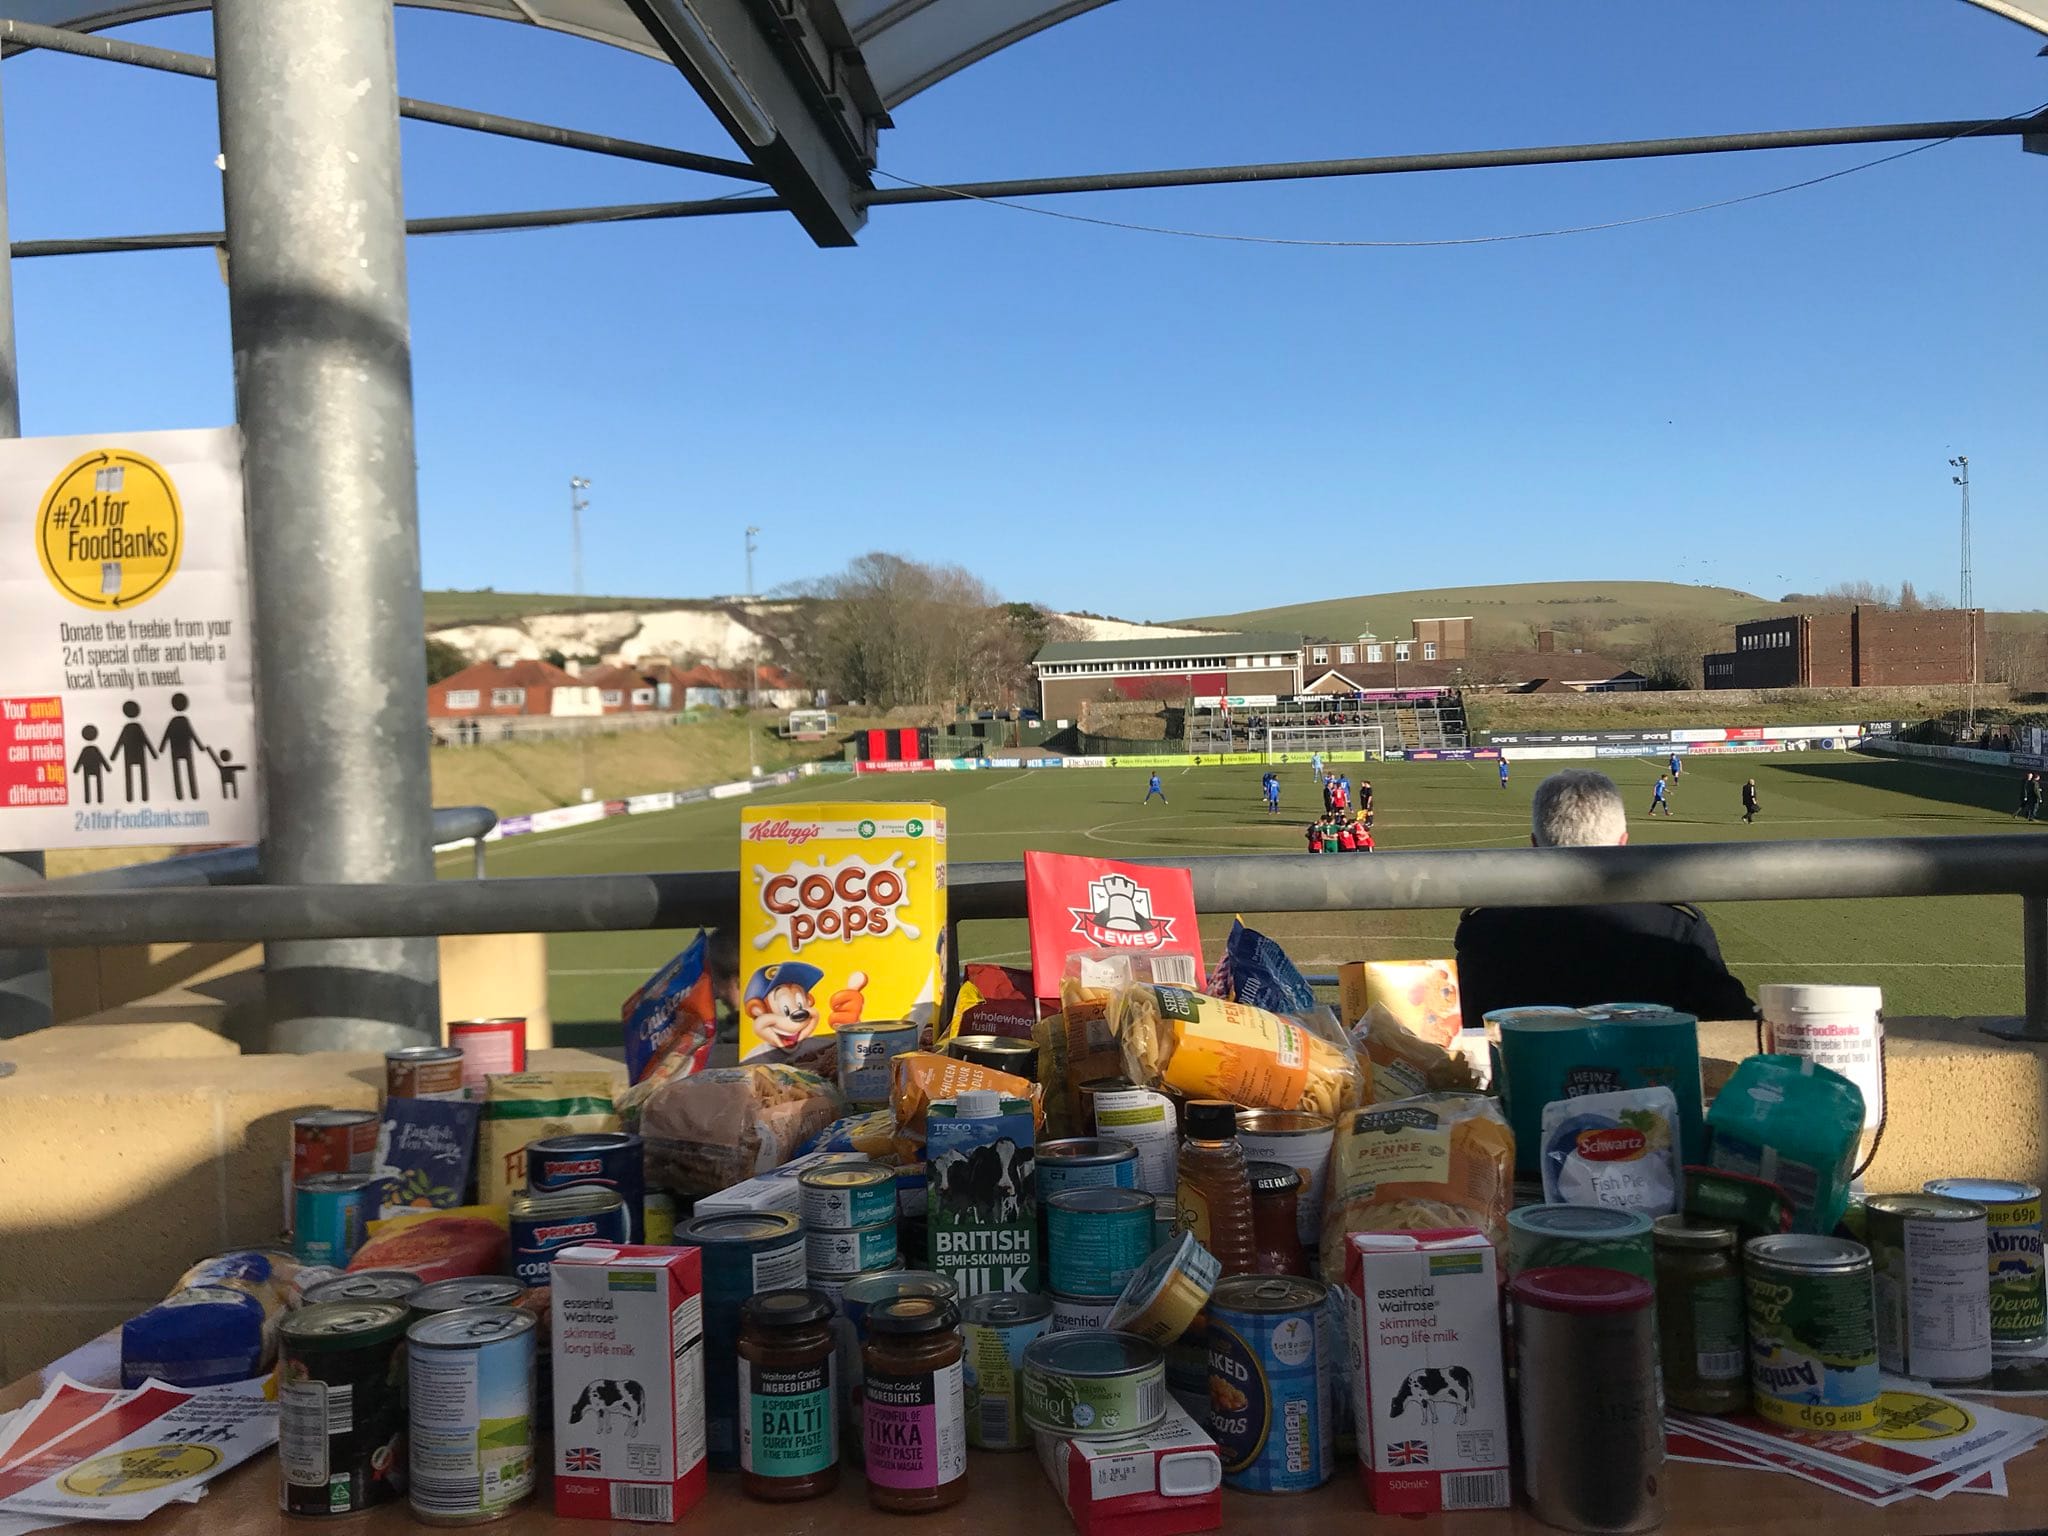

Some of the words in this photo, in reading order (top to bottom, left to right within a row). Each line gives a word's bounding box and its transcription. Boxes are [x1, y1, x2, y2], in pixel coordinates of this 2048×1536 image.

[53, 496, 98, 529] #241
[102, 494, 129, 526] for
[68, 525, 168, 561] FoodBanks
[61, 621, 104, 643] Donate
[106, 620, 126, 640] the
[128, 618, 172, 639] freebie
[174, 617, 205, 638] from
[207, 619, 232, 640] your
[88, 644, 129, 670] special
[132, 643, 160, 664] offer
[165, 641, 187, 662] and
[190, 641, 215, 664] help
[218, 644, 227, 661] a
[65, 668, 95, 690] local
[97, 667, 135, 691] family
[137, 667, 149, 687] in
[4, 700, 28, 719] Your
[30, 700, 62, 718] small
[16, 721, 63, 741] donation
[9, 745, 30, 762] can
[32, 742, 63, 760] make
[1690, 747, 1716, 755] PARKER
[1718, 745, 1749, 754] BUILDING
[1750, 744, 1785, 754] SUPPLIES
[1068, 759, 1080, 768] The
[46, 763, 65, 785] big
[9, 787, 67, 805] difference
[750, 820, 821, 844] Kellogg's
[789, 905, 889, 951] pops
[1093, 926, 1157, 946] LEWES
[972, 1021, 997, 1033] fusilli
[940, 1063, 957, 1097] CHICKEN
[1572, 1071, 1613, 1084] HEINZ
[933, 1123, 971, 1132] TESCO
[1358, 1142, 1422, 1158] PENNE
[1582, 1137, 1643, 1154] Schwartz
[544, 1158, 603, 1178] PRINCES
[1258, 1179, 1273, 1189] GET
[1591, 1176, 1620, 1192] Fish
[1623, 1174, 1644, 1188] Pie
[857, 1191, 874, 1199] tuna
[1600, 1193, 1643, 1207] Sauce
[2012, 1207, 2036, 1223] 69p
[533, 1223, 598, 1244] PRINCES
[936, 1229, 1031, 1252] BRITISH
[936, 1253, 1031, 1267] SEMI-SKIMMED
[1377, 1285, 1435, 1299] essential
[563, 1297, 614, 1310] essential
[1378, 1300, 1435, 1312] Waitrose
[1990, 1292, 2041, 1313] Devon
[564, 1311, 614, 1323] Waitrose
[1054, 1313, 1099, 1328] essential
[1379, 1316, 1437, 1331] skimmed
[1990, 1310, 2045, 1330] ustard
[563, 1328, 616, 1340] skimmed
[1380, 1334, 1409, 1348] long
[1411, 1332, 1431, 1344] life
[1433, 1329, 1459, 1344] milk
[564, 1342, 590, 1357] long
[592, 1342, 609, 1355] life
[611, 1343, 635, 1356] milk
[1208, 1352, 1249, 1382] AKED
[761, 1370, 796, 1382] Waitrose
[762, 1378, 821, 1393] INGREDIENTS
[769, 1398, 811, 1411] SPOONFUL
[762, 1407, 822, 1435] BALTI
[910, 1410, 921, 1421] OF
[1211, 1410, 1248, 1435] eans
[1800, 1405, 1837, 1427] 69p
[1839, 1410, 1862, 1423] RRP
[762, 1436, 794, 1449] CURRY
[795, 1432, 822, 1448] PASTE
[869, 1418, 923, 1446] TIKKA
[893, 1447, 923, 1460] PASTE
